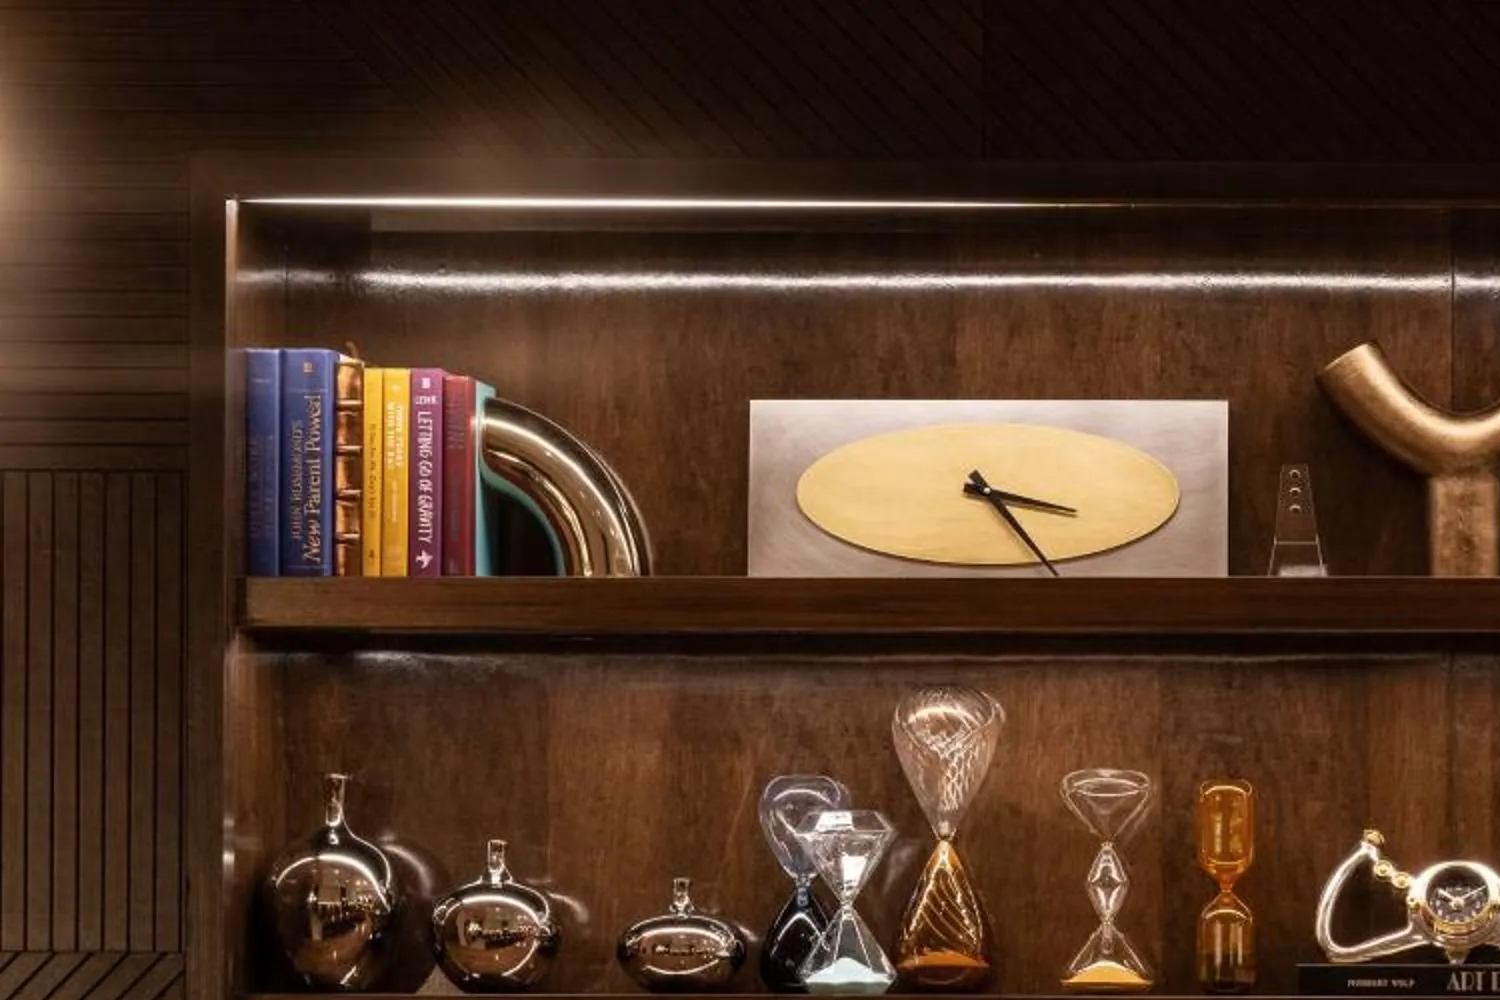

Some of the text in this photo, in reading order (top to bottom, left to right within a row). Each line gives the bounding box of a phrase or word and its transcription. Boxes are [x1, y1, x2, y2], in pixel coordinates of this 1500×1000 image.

[417, 411, 433, 458] LETTING
[303, 395, 322, 563] New Parent Power!
[417, 460, 433, 476] GO
[417, 479, 433, 494] OF
[417, 495, 433, 543] GRAVITY
[1447, 970, 1486, 992] ART
